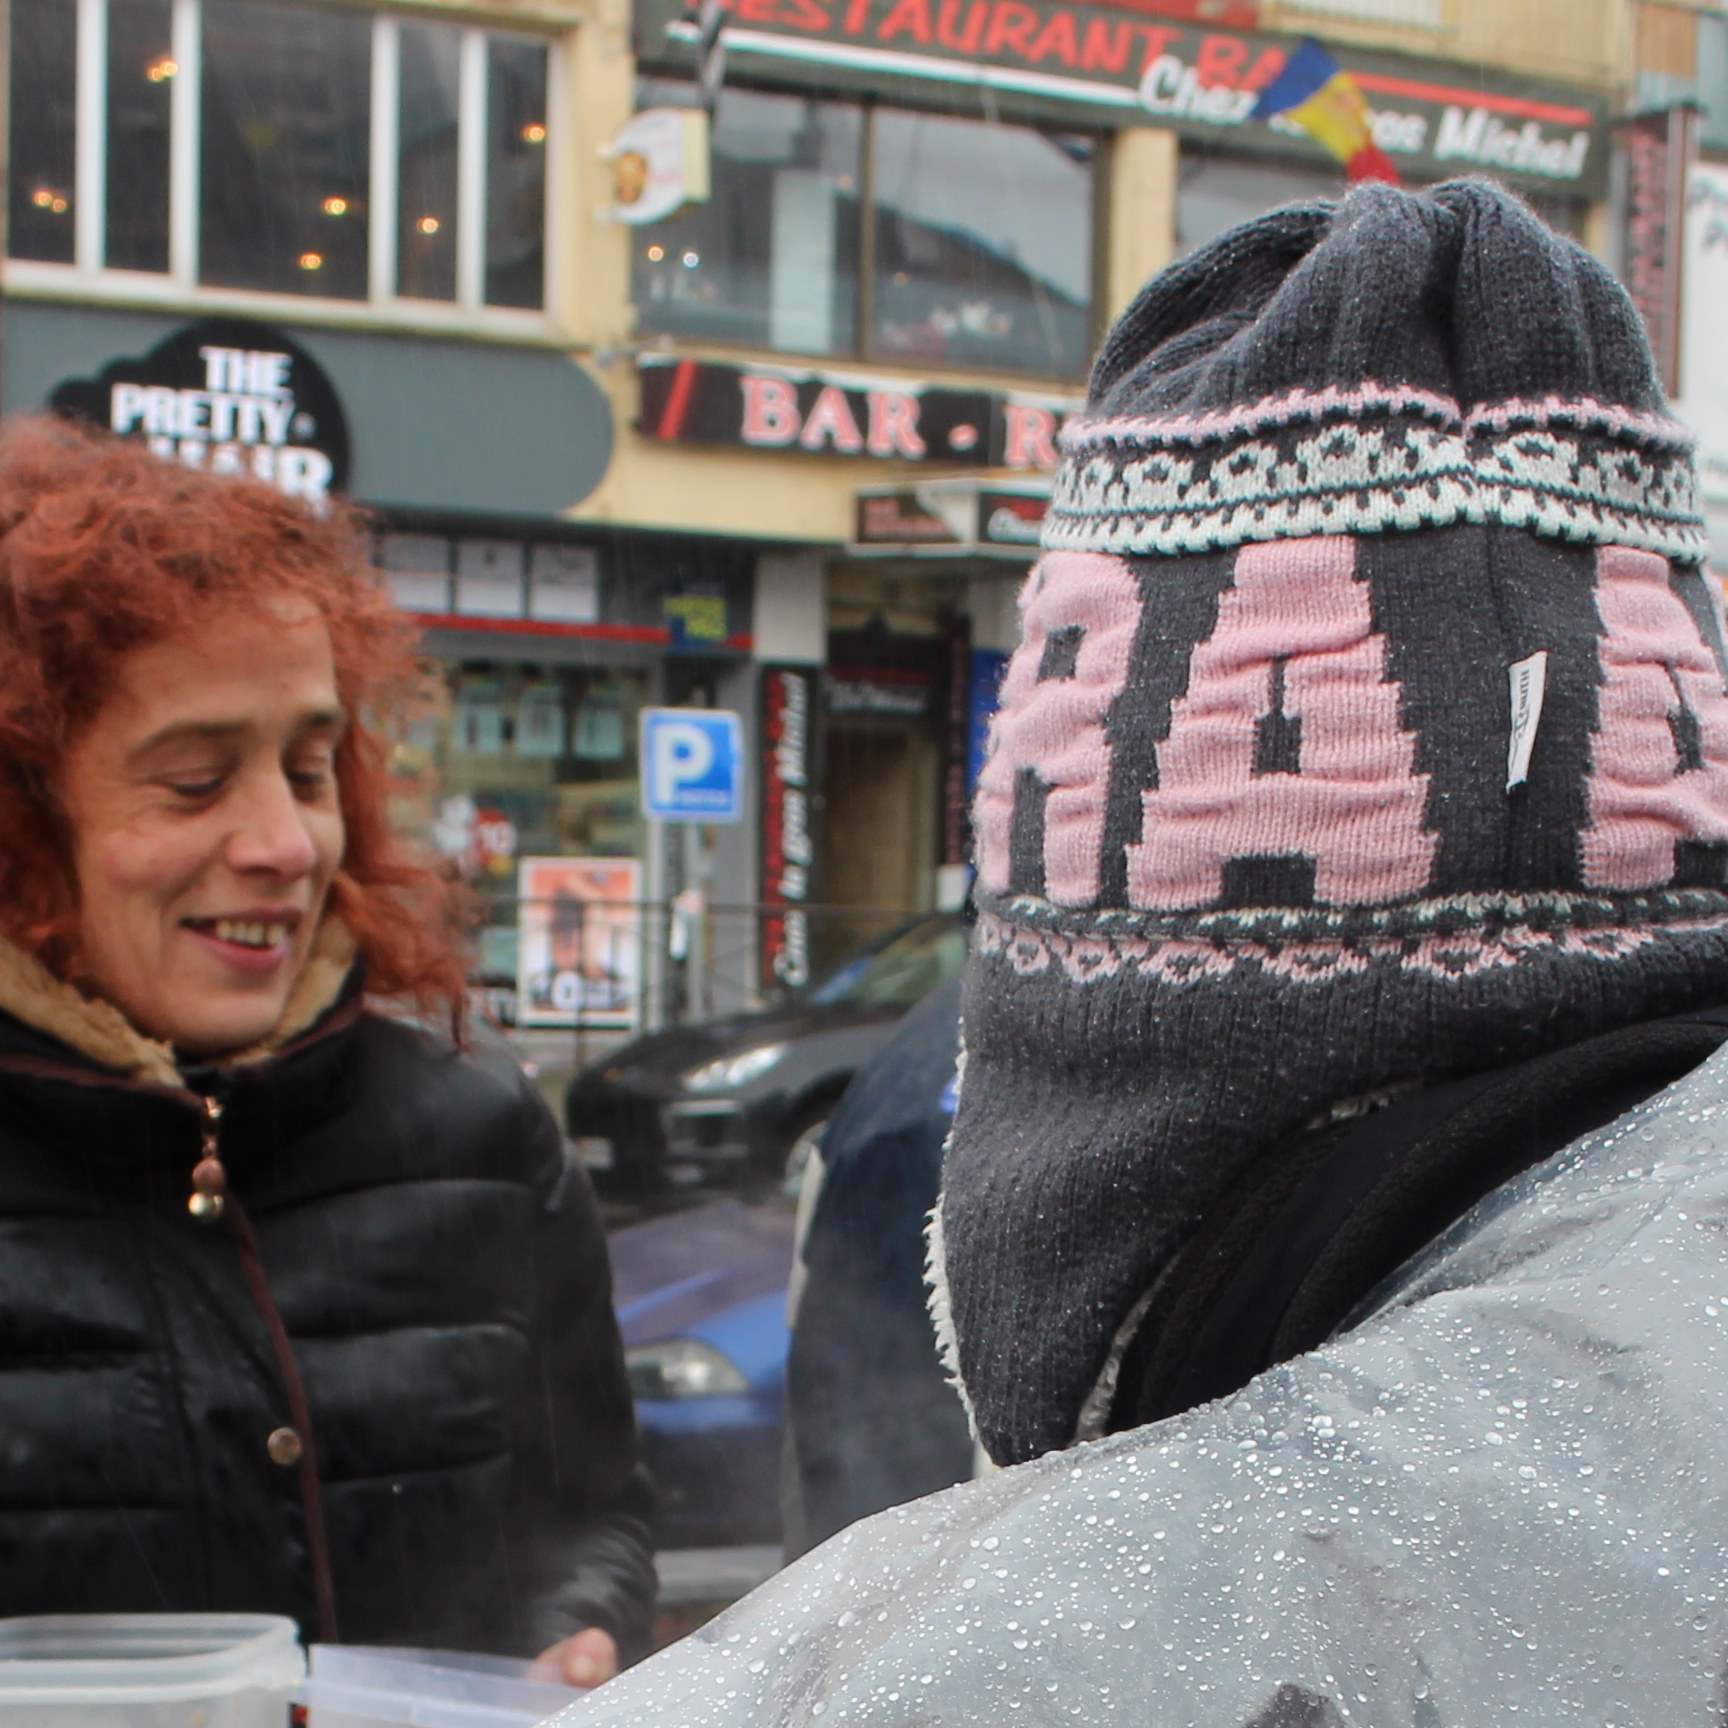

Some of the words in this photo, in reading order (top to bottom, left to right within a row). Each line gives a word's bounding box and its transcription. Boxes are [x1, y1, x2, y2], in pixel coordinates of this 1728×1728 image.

[684, 0, 1178, 76] STAURANT
[1194, 32, 1289, 92] BA
[1433, 104, 1590, 180] Michel
[199, 345, 295, 398] THE
[110, 381, 296, 446] PRETTY
[739, 373, 927, 462] BAR
[655, 723, 714, 804] P
